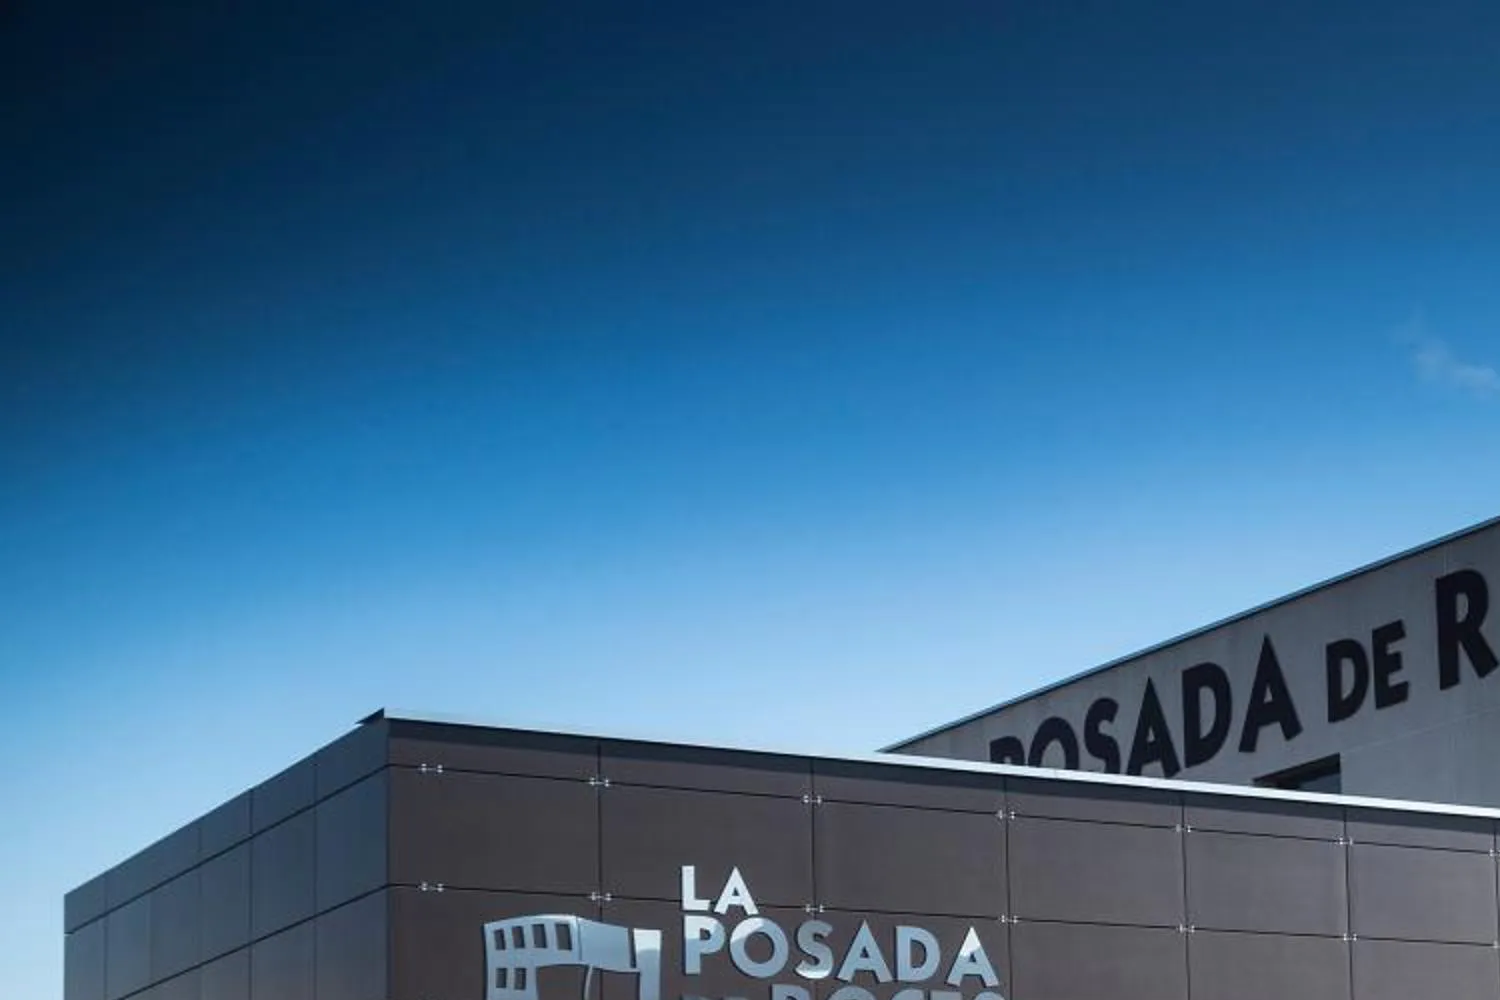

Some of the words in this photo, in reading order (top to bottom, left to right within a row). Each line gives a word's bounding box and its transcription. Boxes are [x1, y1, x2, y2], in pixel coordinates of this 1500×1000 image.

[1326, 619, 1410, 724] DE
[681, 865, 759, 915] LA
[683, 915, 1000, 988] POSADA
